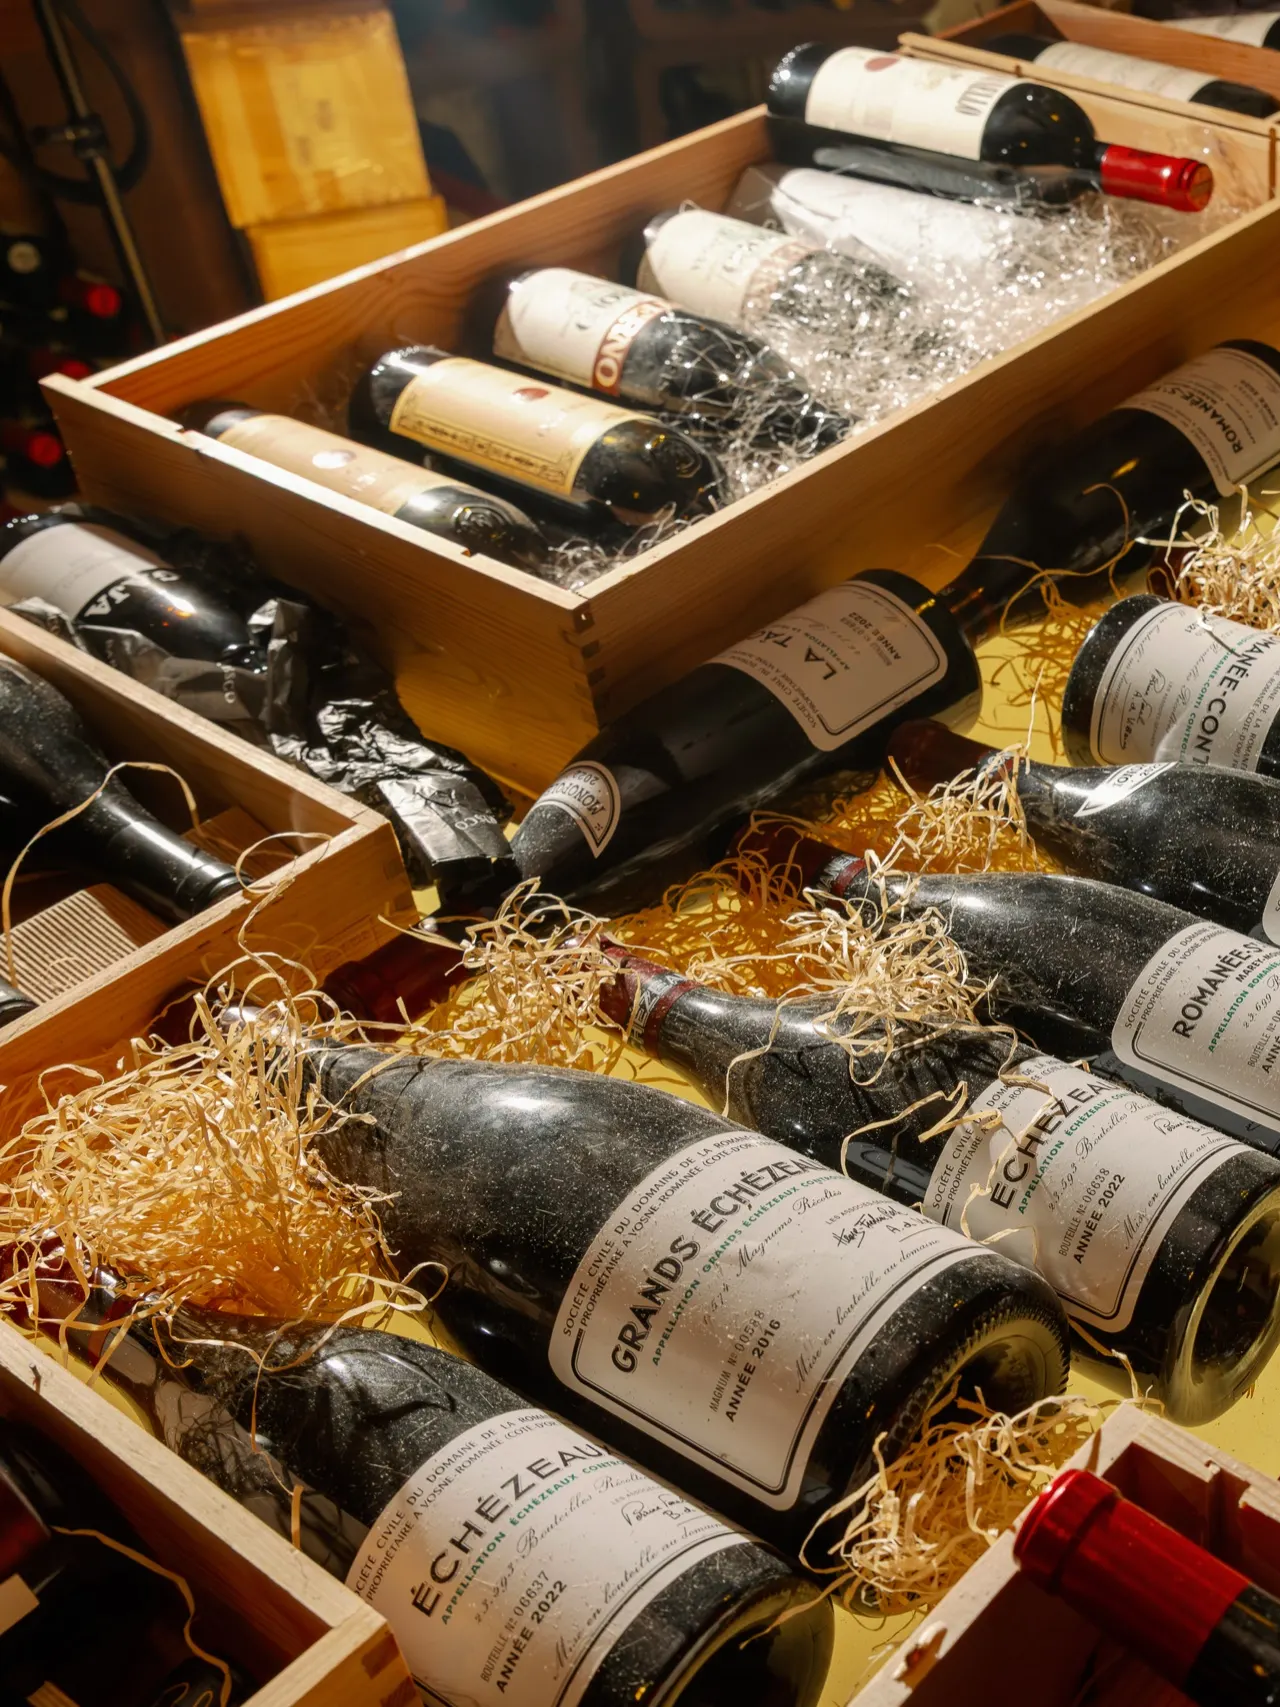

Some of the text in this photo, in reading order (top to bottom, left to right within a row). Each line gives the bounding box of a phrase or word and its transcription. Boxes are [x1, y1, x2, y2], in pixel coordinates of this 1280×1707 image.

[804, 645, 837, 681] LA
[1148, 960, 1170, 986] CIVILE
[1167, 947, 1179, 959] DU
[1208, 990, 1249, 1053] APPELLATION
[1248, 1032, 1271, 1067] BOUTEILLE
[952, 1128, 975, 1159] CIVILE
[1018, 1140, 1065, 1215] APPELLATION
[587, 1239, 615, 1277] CIVILE
[614, 1216, 631, 1236] DU
[631, 1169, 679, 1213] DOMAINE
[679, 1157, 696, 1169] DE
[699, 1147, 713, 1158] LA
[1058, 1168, 1110, 1257] BOUTEILLE 06638
[1073, 1173, 1126, 1264] ANNÉE 2022
[1148, 1192, 1159, 1208] en
[611, 1235, 700, 1374] GRANDS
[690, 1158, 828, 1234] ÉCHÉZEAU
[652, 1278, 700, 1366] APPELLATION
[702, 1228, 743, 1274] GRANDS
[742, 1186, 800, 1228] ÉCHÉZEAUX
[736, 1217, 793, 1278] Magnums
[823, 1328, 837, 1346] en
[836, 1271, 882, 1326] bouteille
[708, 1310, 766, 1413] MAGNUM 00588
[725, 1319, 781, 1423] ANNÉE 2016
[376, 1420, 515, 1550] CIVILE DU DOMAINE DE LA
[411, 1443, 612, 1618] ÉCHÉZEAU
[441, 1472, 579, 1625] APPELLATION ÉCHÉZEAUX
[480, 1570, 551, 1683] BOUTEILLE 06637
[586, 1607, 601, 1627] en
[603, 1545, 659, 1605] bouteille
[495, 1579, 568, 1695] ANNÉE 2022
